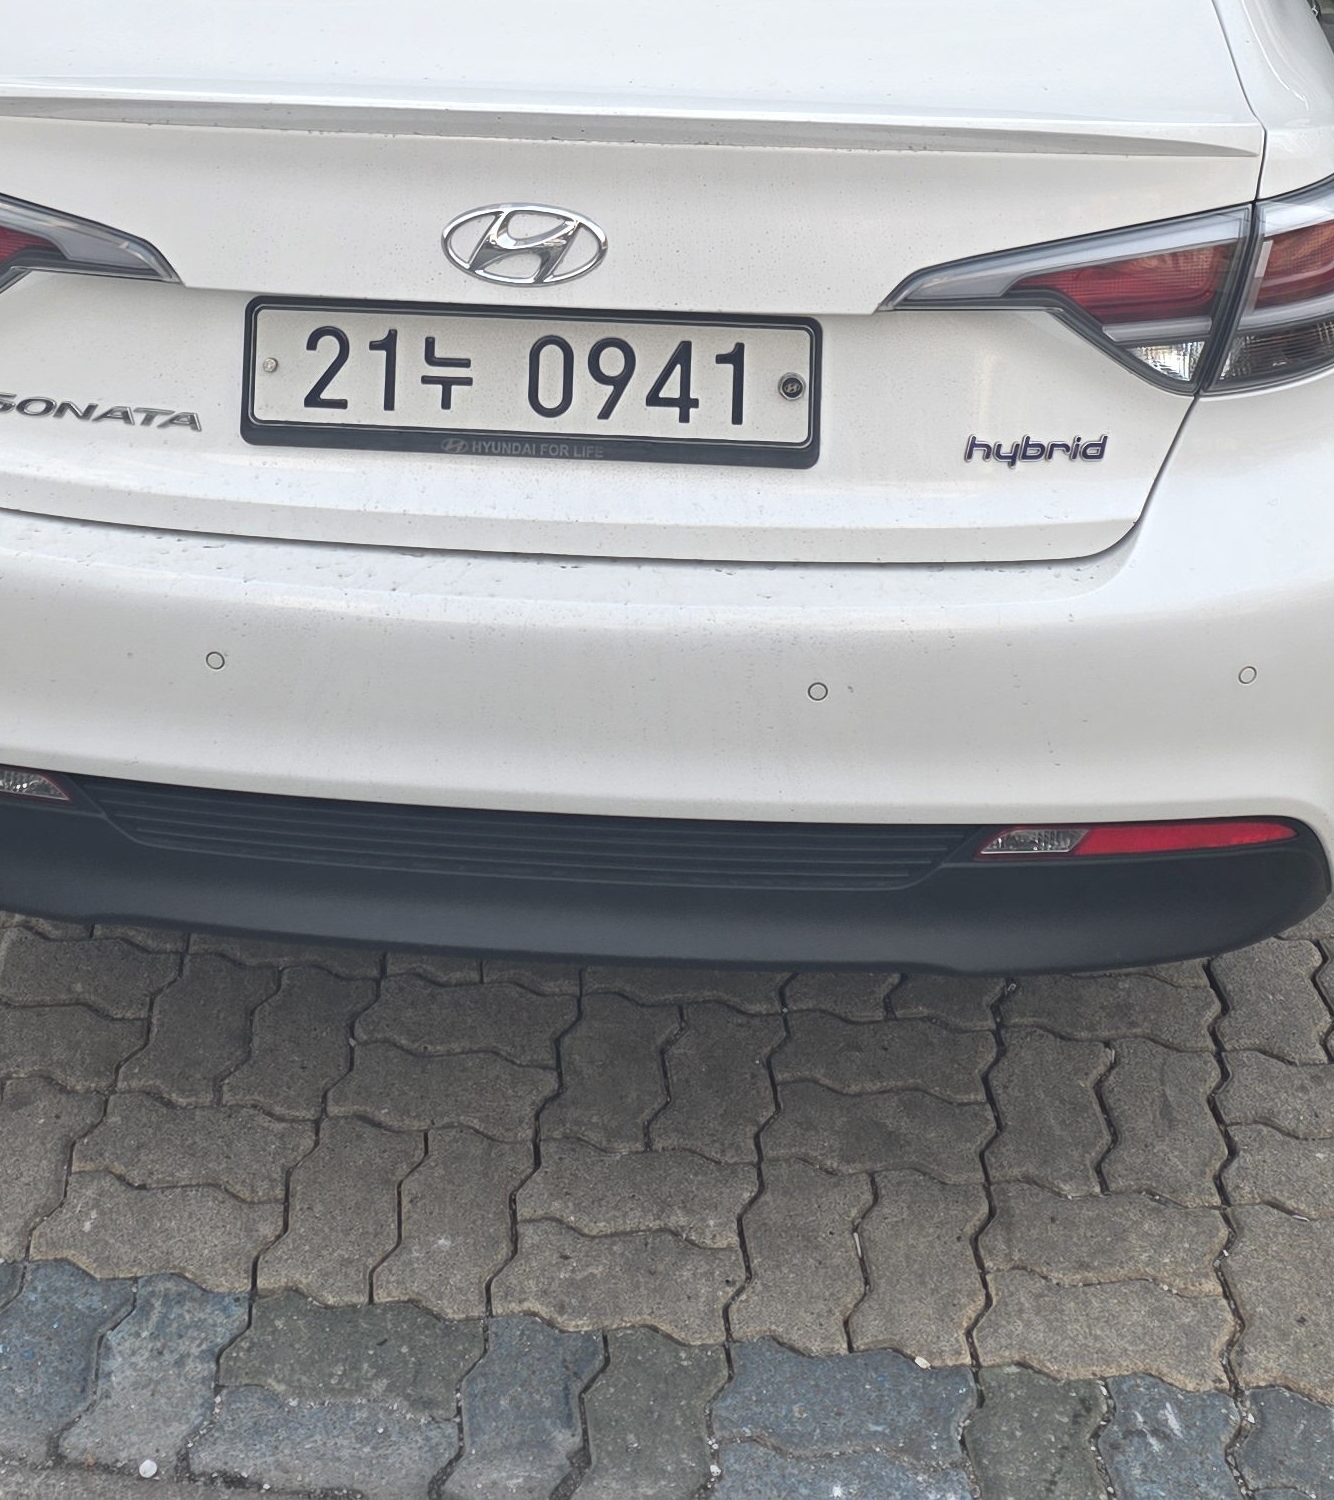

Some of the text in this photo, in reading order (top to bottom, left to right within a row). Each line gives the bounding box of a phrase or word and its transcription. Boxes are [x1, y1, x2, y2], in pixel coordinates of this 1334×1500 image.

[303, 326, 746, 426] 21누 0941
[471, 441, 604, 459] HYUNDAI FOR LIFE
[964, 434, 1109, 469] hybrid
